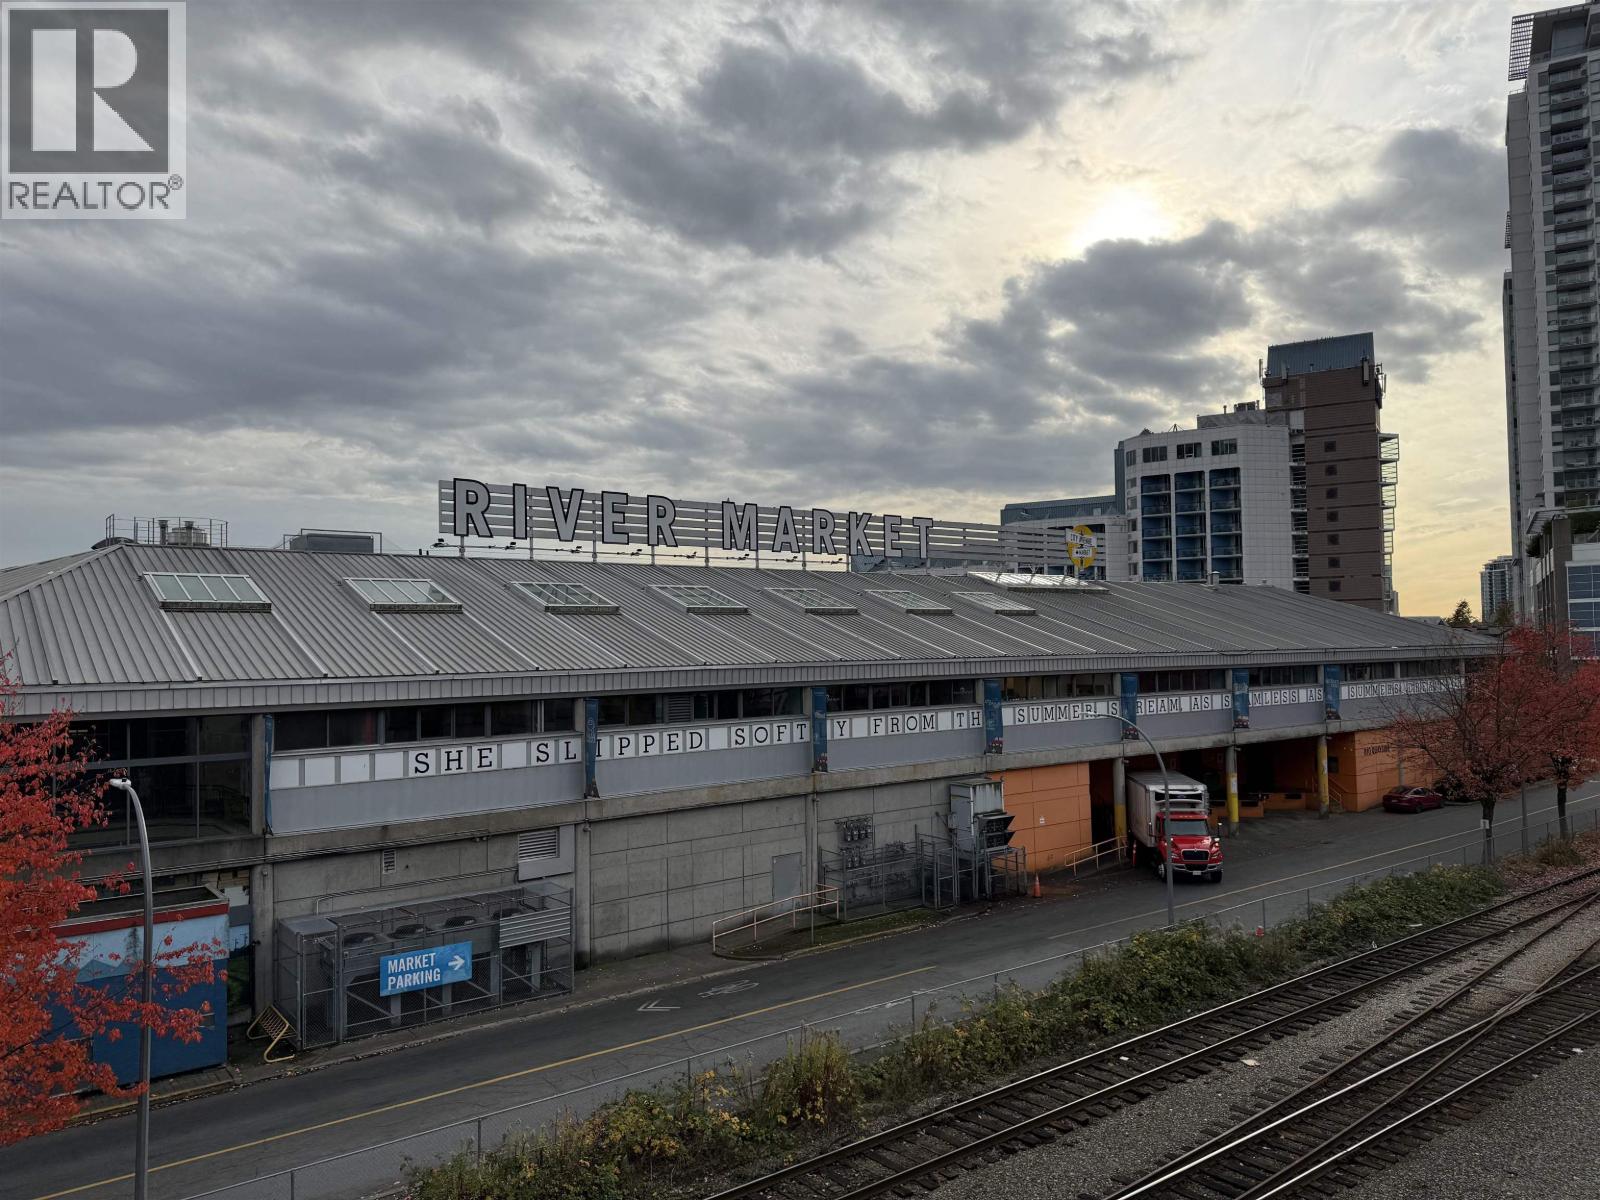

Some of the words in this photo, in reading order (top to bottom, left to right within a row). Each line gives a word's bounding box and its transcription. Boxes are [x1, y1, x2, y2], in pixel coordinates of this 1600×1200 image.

[453, 477, 678, 548] RIVER
[721, 500, 934, 559] MARKET
[414, 747, 493, 774] SHE
[734, 718, 849, 746] SOFTY
[872, 713, 936, 735] FROM
[955, 710, 993, 728] TH
[1111, 698, 1183, 716] SREAM,
[1192, 695, 1210, 710] AS
[1224, 690, 1297, 708] SMLESS
[1307, 688, 1323, 702] AS
[387, 952, 437, 975] MARKET
[387, 968, 441, 991] PARKING
